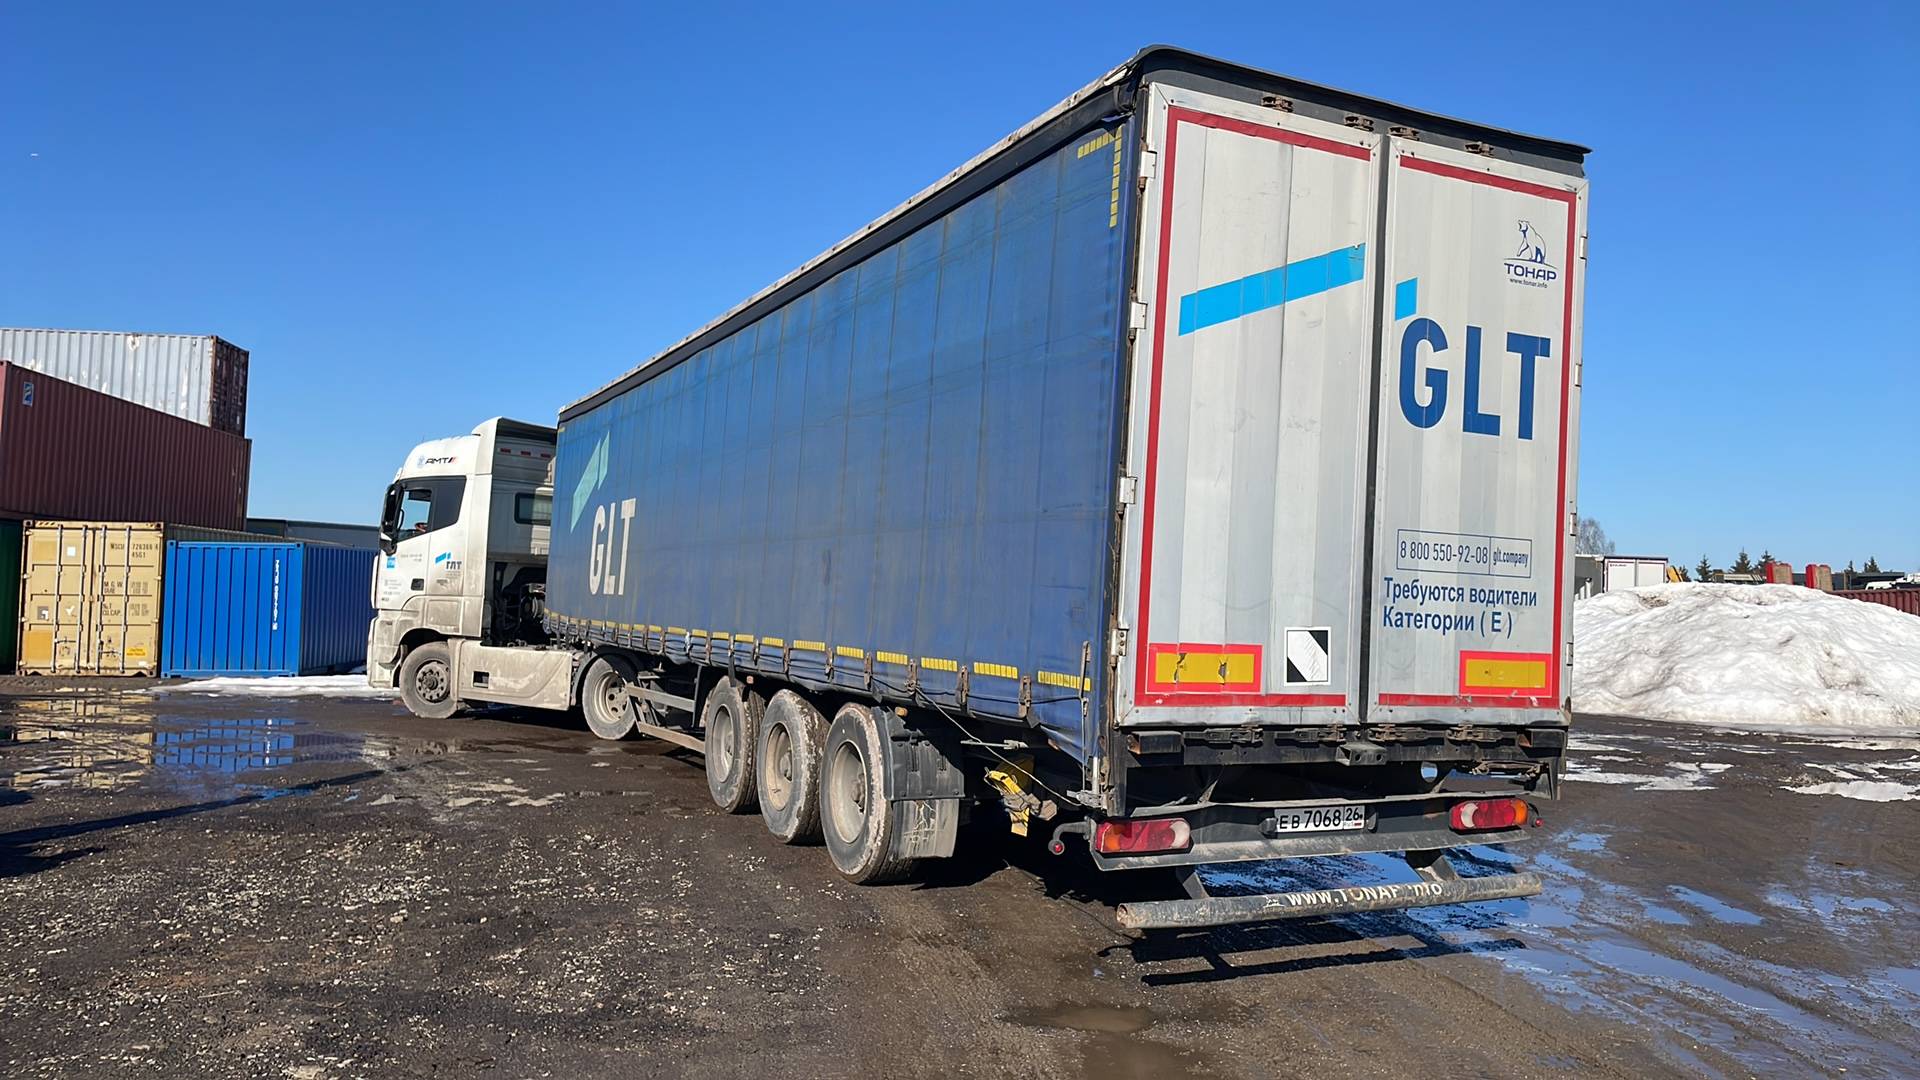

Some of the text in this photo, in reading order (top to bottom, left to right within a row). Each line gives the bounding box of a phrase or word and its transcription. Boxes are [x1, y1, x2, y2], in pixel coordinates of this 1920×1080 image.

[1503, 262, 1557, 281] ТОНАР
[1399, 317, 1551, 440] GLT
[589, 498, 637, 596] GLT
[1400, 540, 1489, 564] 8 800 550-92-08
[1492, 547, 1529, 568] glt.company
[446, 561, 462, 570] ГЛТ
[1384, 577, 1537, 608] Требуются водители
[1383, 606, 1475, 635] Категории
[1345, 807, 1360, 822] 26
